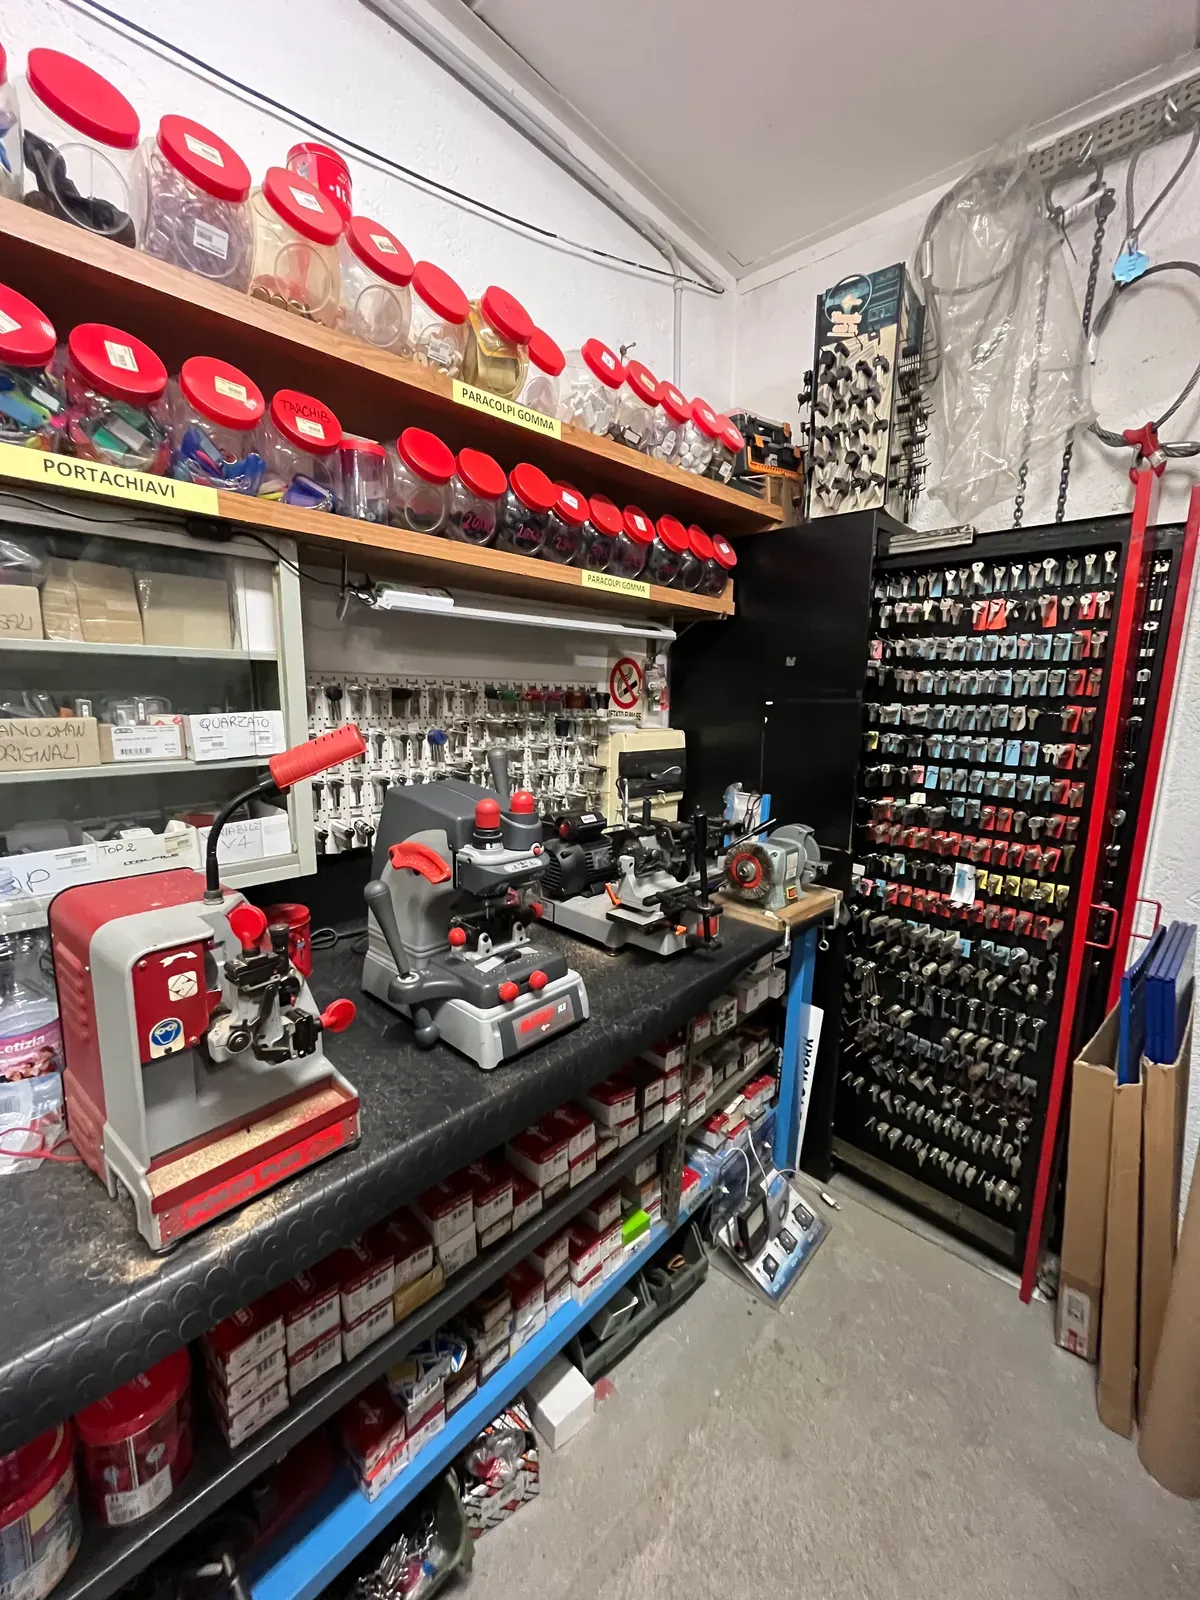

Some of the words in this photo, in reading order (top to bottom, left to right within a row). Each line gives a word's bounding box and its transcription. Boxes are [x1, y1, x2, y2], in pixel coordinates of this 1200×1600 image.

[462, 387, 516, 416] PARACOLPI
[518, 409, 555, 431] GOMMA
[43, 458, 175, 499] PORTACHIAVI
[587, 574, 621, 589] PARACOLPI
[622, 581, 646, 593] GOMMA
[200, 714, 270, 731] QUARZATO
[99, 843, 124, 854] TOP
[126, 843, 137, 852] 2
[0, 1035, 46, 1055] etizia
